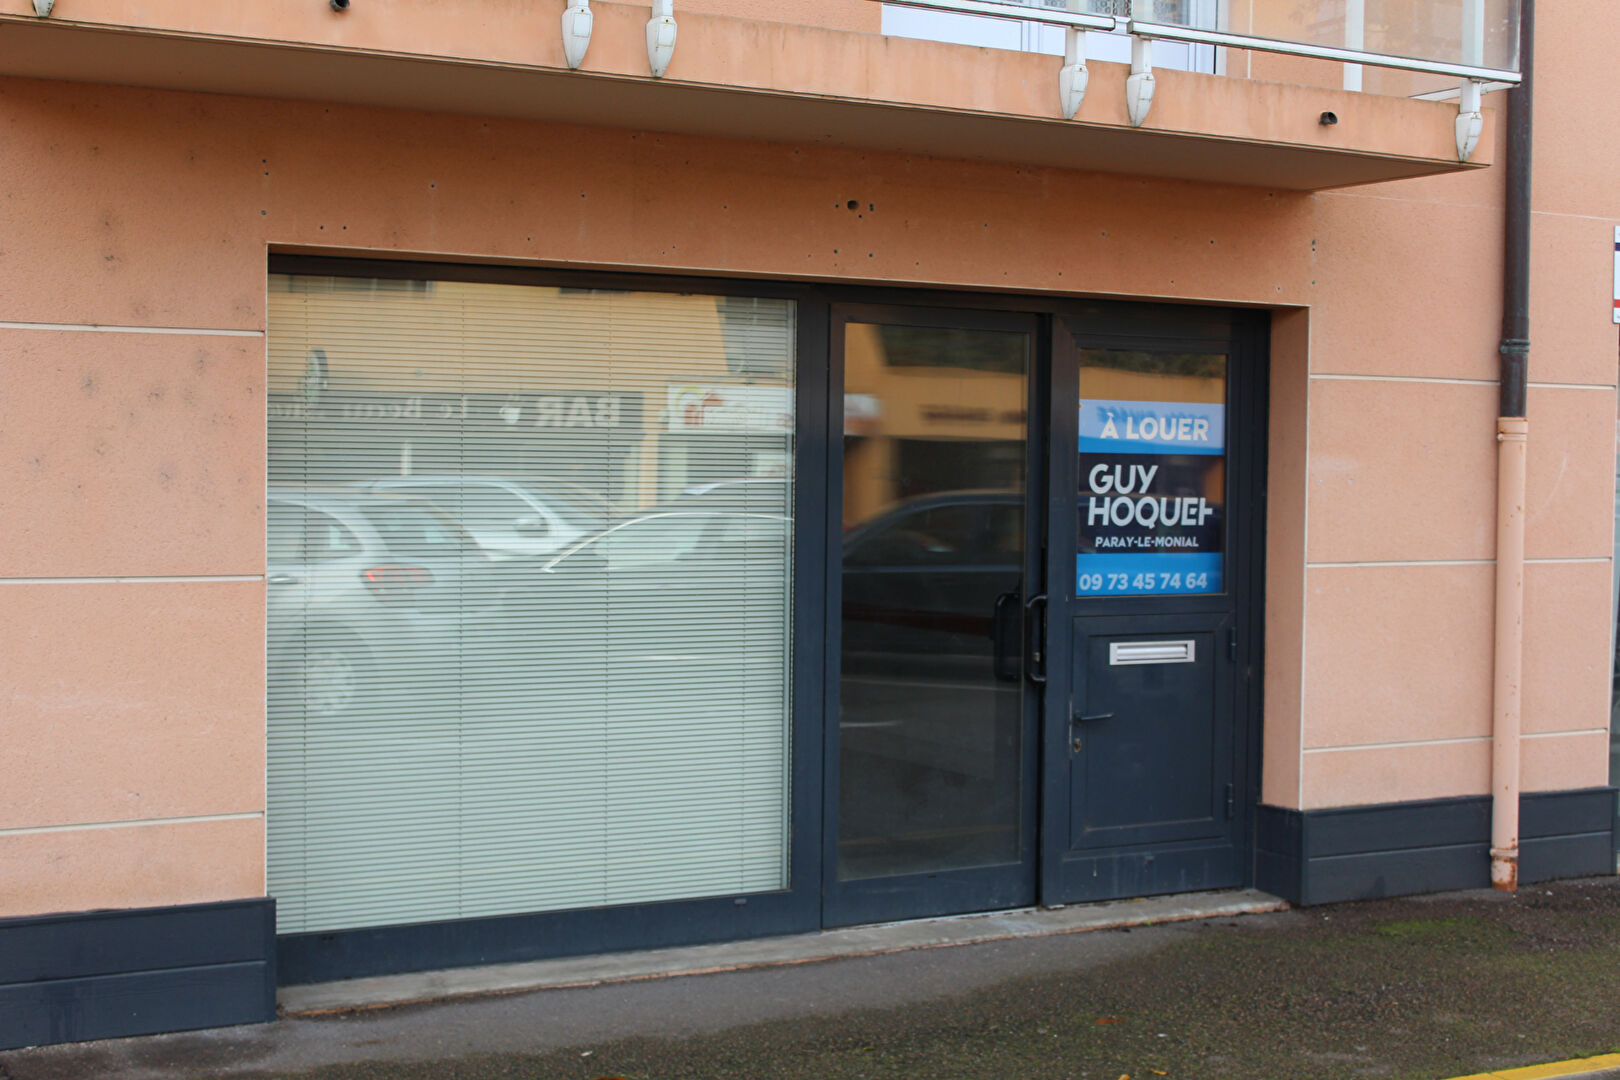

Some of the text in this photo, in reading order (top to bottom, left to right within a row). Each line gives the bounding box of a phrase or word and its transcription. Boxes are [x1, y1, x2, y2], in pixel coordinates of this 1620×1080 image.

[1099, 411, 1209, 442] À LOUER
[1088, 463, 1159, 495] GUY
[1094, 536, 1199, 548] PARAY-LE-MONIAL
[1079, 572, 1208, 591] 09 73 45 74 64
